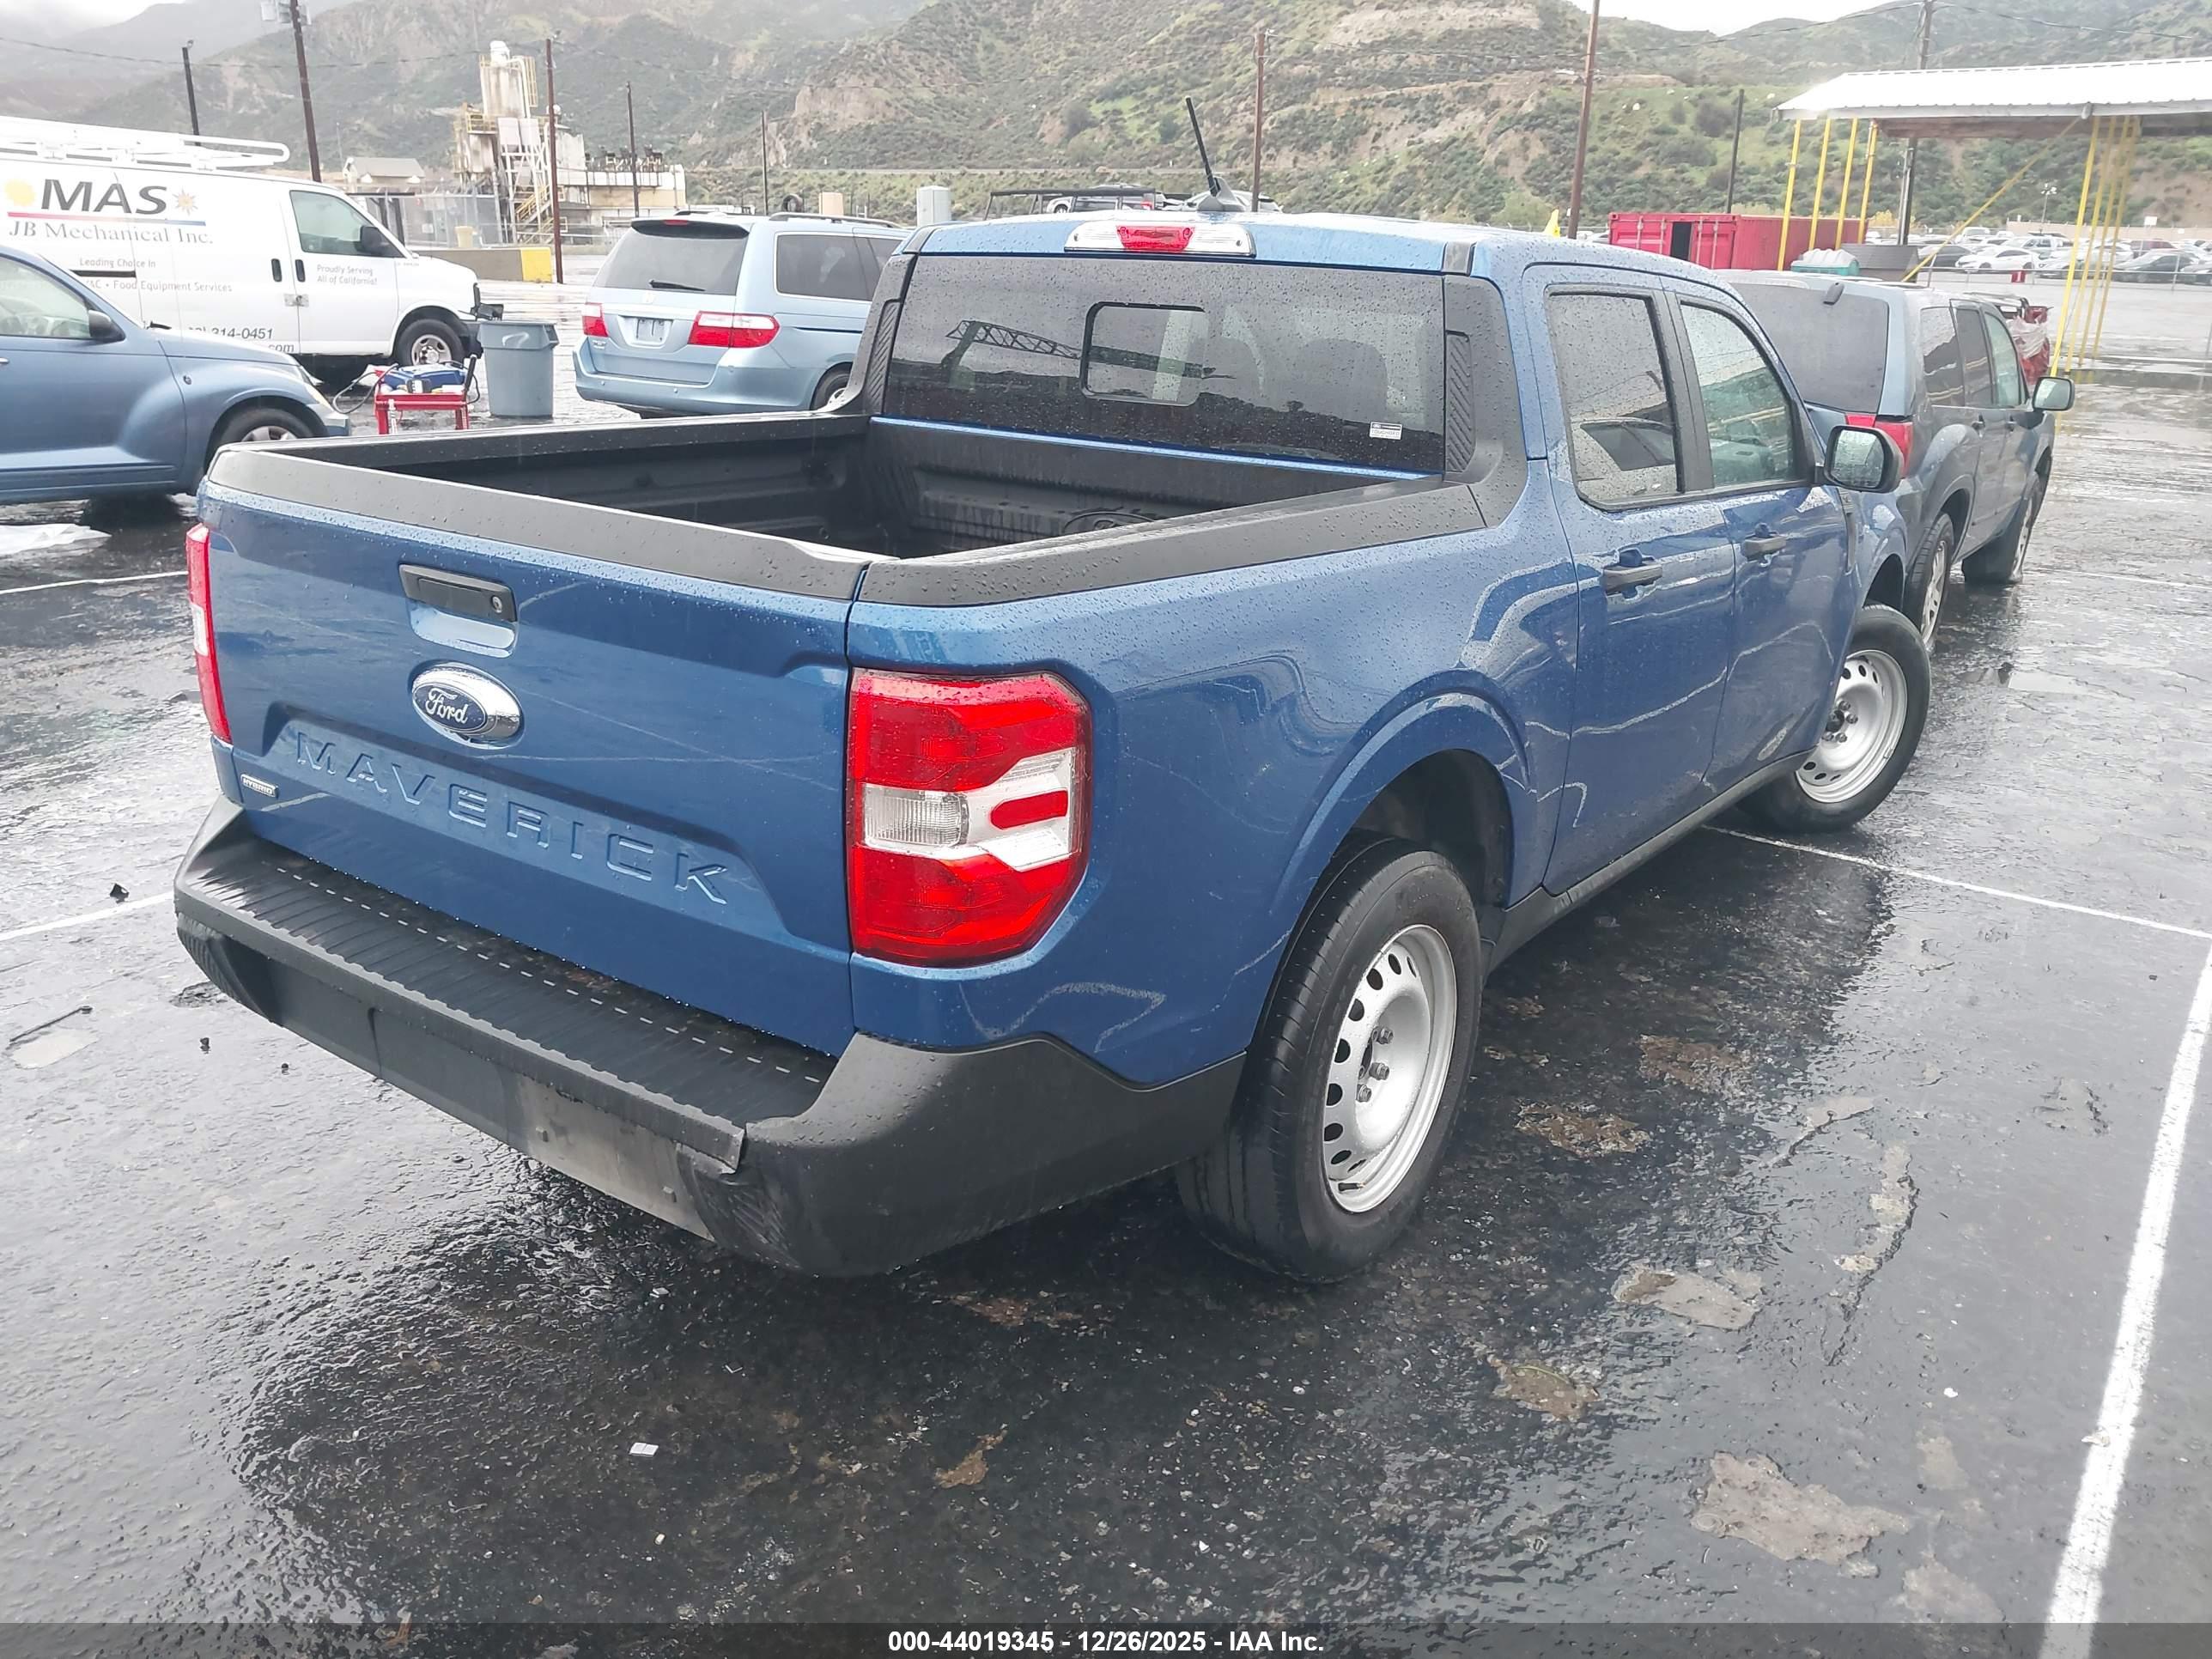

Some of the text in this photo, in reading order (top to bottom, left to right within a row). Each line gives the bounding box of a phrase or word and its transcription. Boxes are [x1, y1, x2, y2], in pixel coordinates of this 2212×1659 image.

[41, 179, 167, 215] MAS
[9, 221, 214, 244] JB Mechanical Inc.
[80, 258, 114, 268] Leading
[117, 258, 145, 268] Choice
[317, 264, 374, 276] Proudly Serving
[113, 280, 137, 289] Food
[141, 281, 191, 293] Equipment
[194, 282, 233, 293] Services
[425, 687, 469, 724] Ford
[296, 732, 727, 904] MAVERICK
